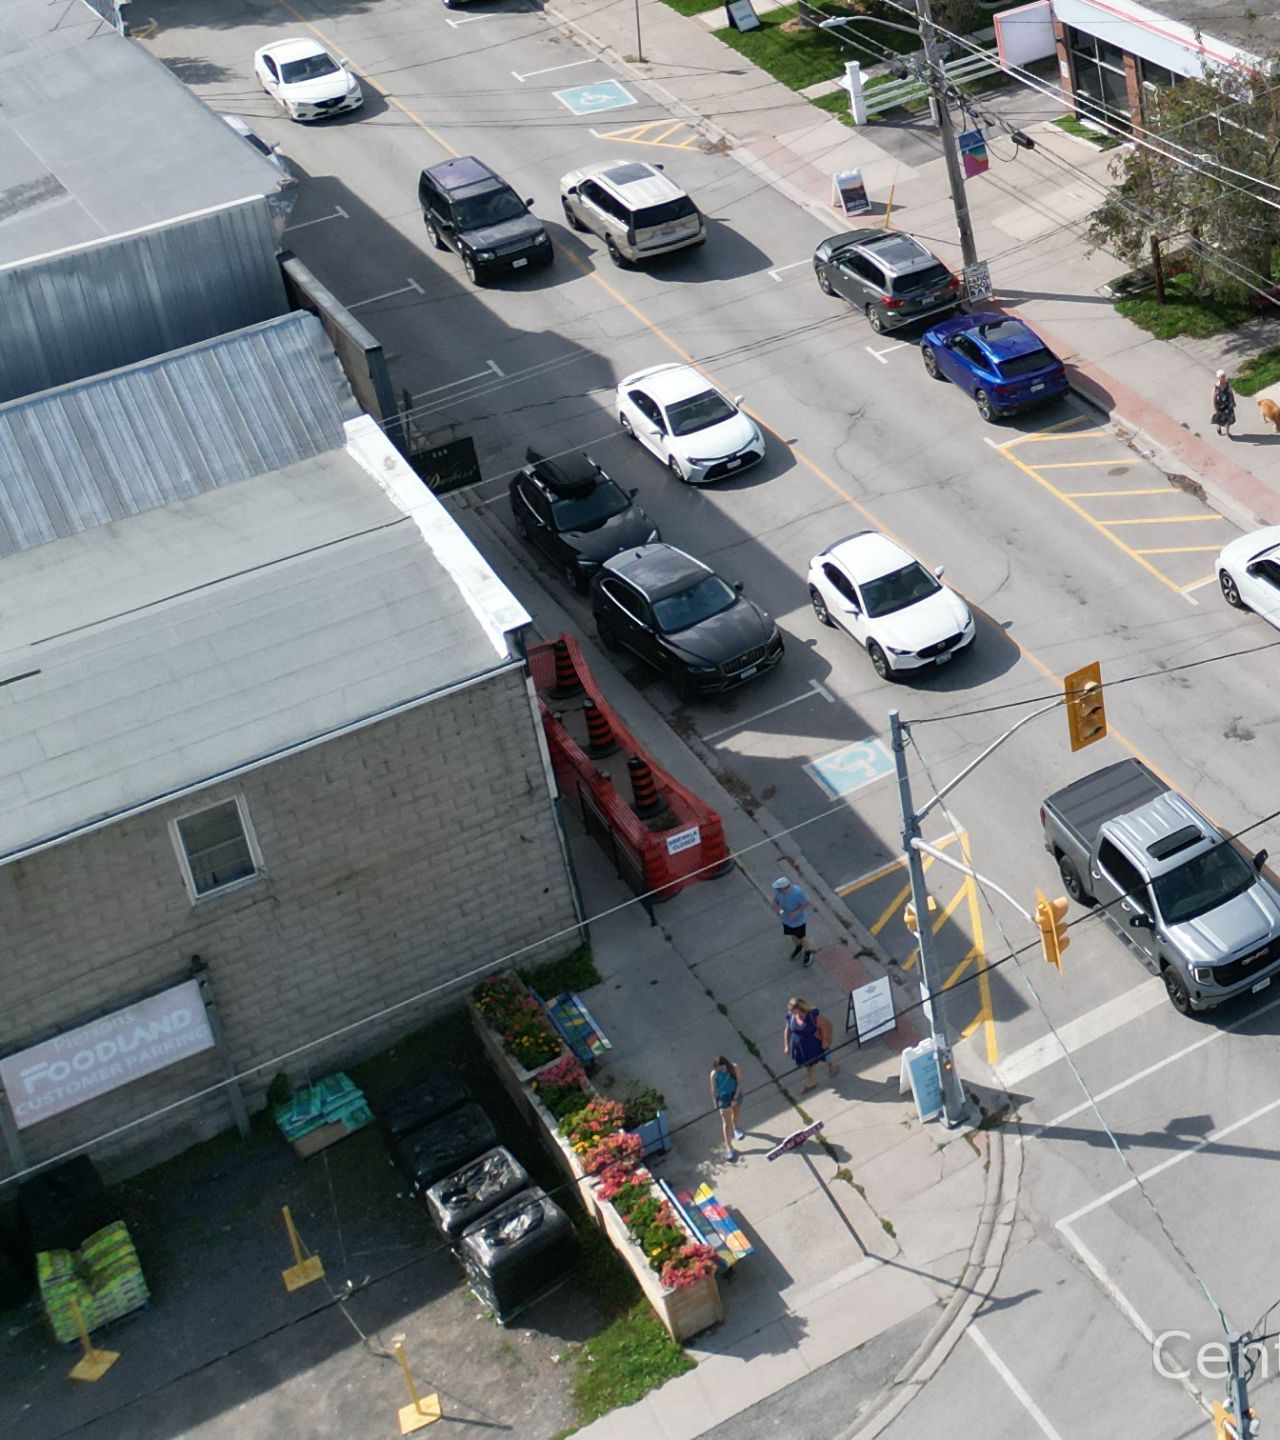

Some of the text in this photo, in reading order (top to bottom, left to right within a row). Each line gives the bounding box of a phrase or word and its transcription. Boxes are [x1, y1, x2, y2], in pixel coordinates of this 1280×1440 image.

[16, 1024, 212, 1116] CUSTOMER PARKING
[20, 1010, 193, 1094] FOODLAND
